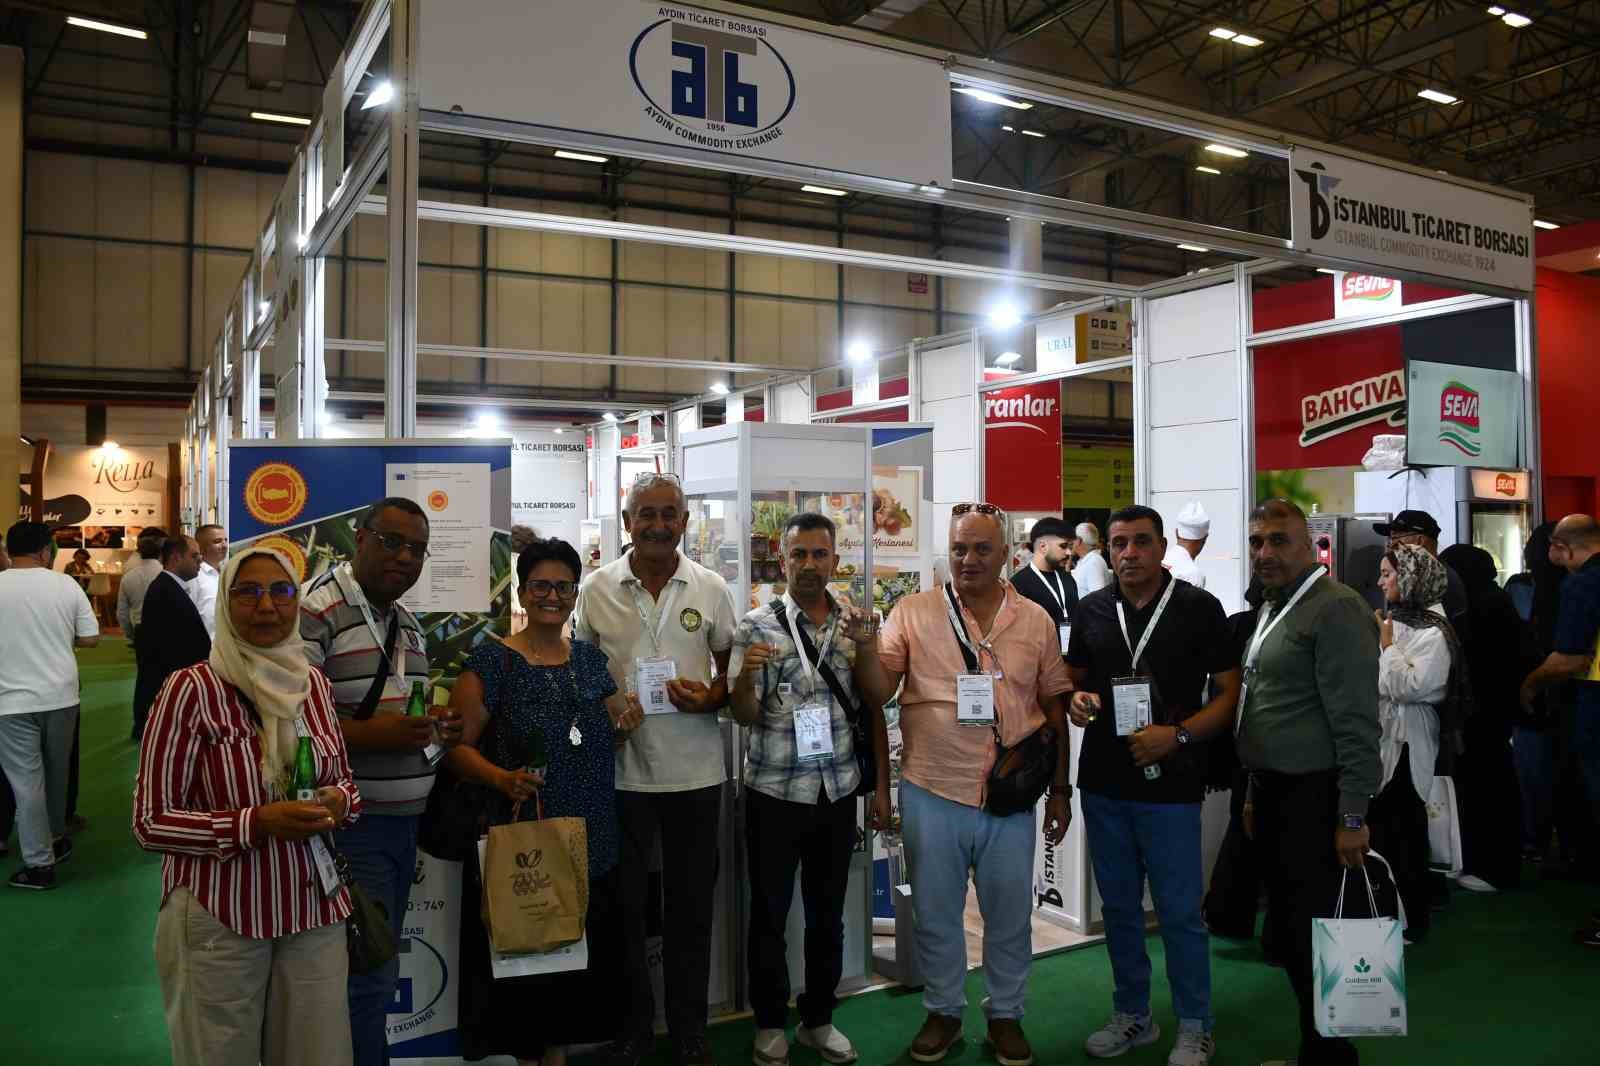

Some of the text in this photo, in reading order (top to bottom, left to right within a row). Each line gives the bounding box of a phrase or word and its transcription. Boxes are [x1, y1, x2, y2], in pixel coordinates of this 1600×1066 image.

[658, 8, 685, 19] AYDIN
[728, 22, 767, 37] BORSASI
[645, 105, 784, 149] AYDIN COMMODITY EXCHANGE
[1474, 226, 1529, 258] BORSASI
[1475, 255, 1496, 272] 1924
[423, 901, 445, 911] 749
